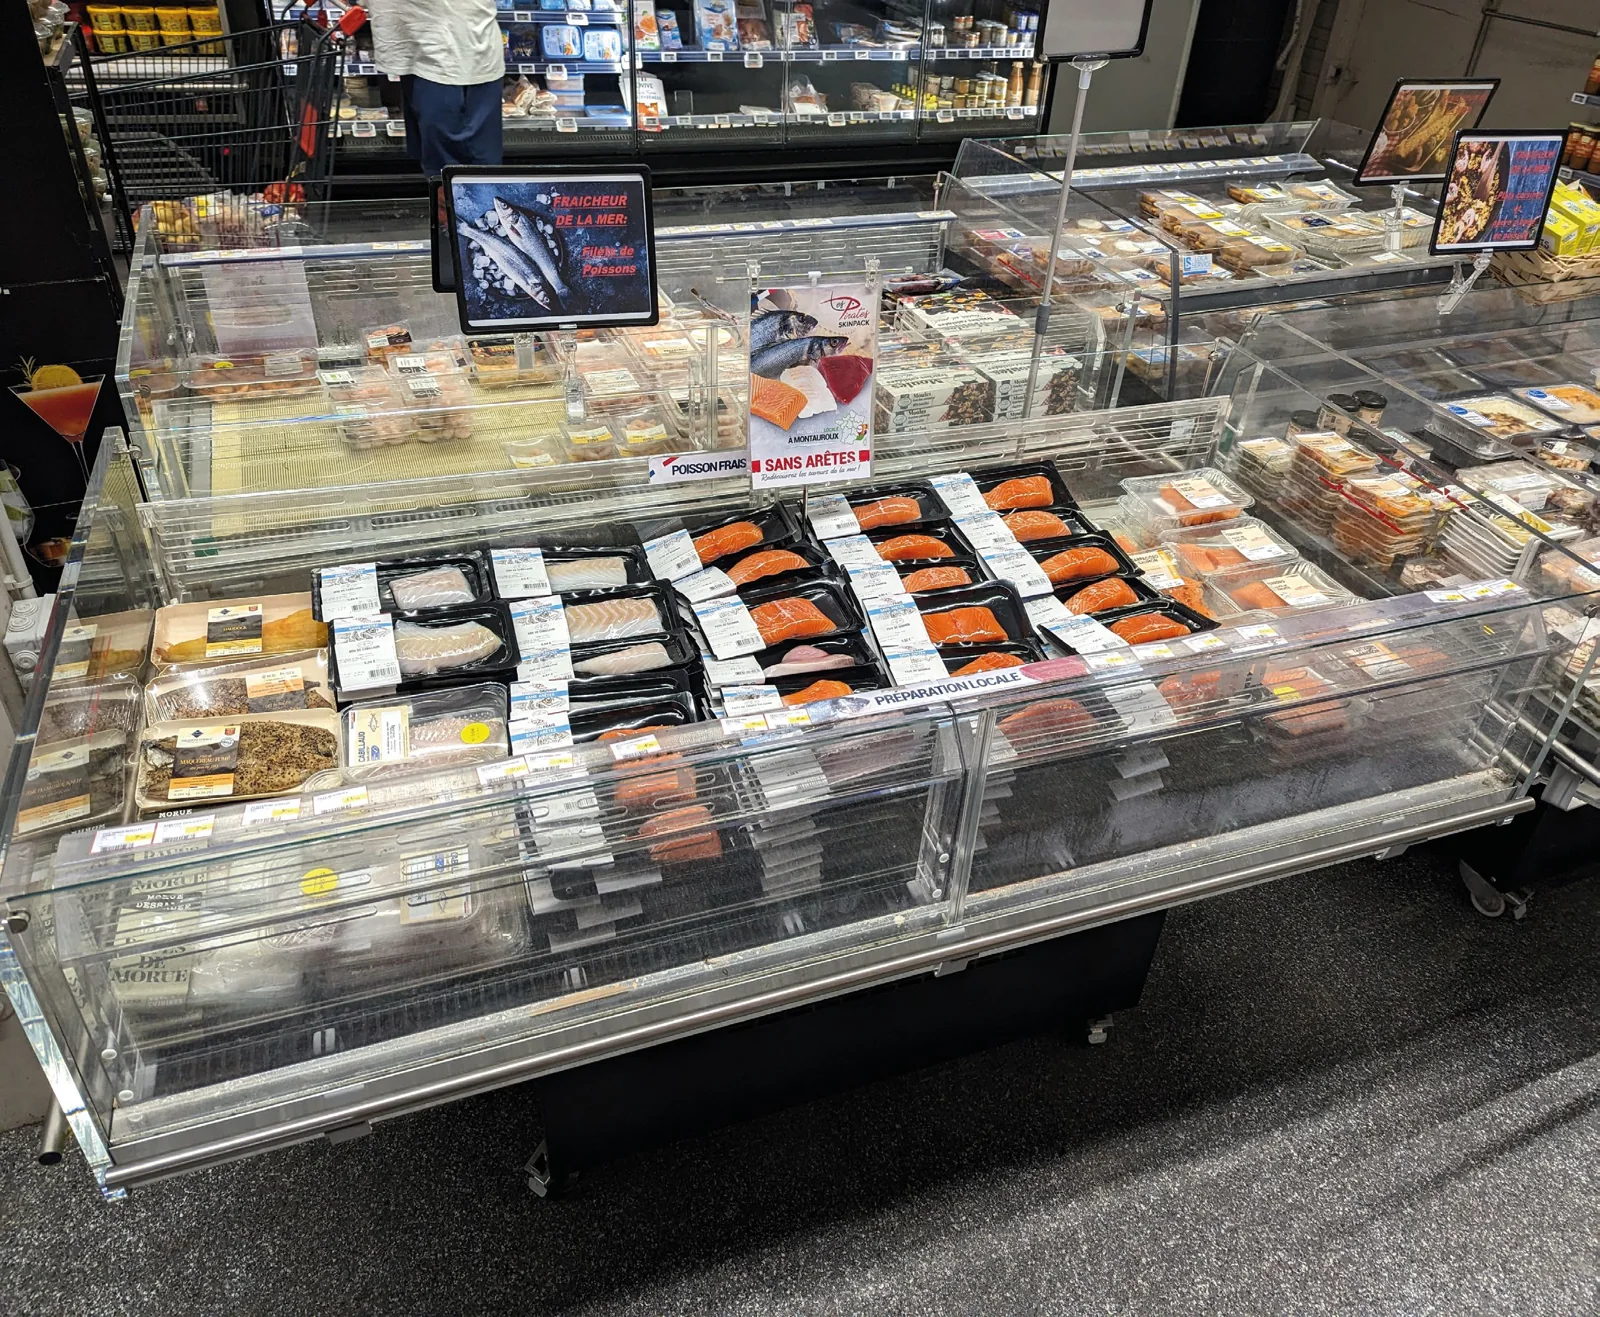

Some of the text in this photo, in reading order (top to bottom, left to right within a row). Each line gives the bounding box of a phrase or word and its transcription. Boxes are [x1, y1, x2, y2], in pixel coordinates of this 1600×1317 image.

[552, 195, 628, 208] FRAICHEUR
[556, 213, 628, 226] DE LA MER:
[620, 246, 634, 256] de
[582, 264, 636, 276] Poissons
[838, 320, 870, 328] SKINPACK
[794, 433, 839, 443] MONTAUROUX
[672, 458, 747, 476] POISSON FRAIS
[766, 450, 856, 472] SANS ARÊTES
[874, 672, 1021, 706] PRÉPARATION LOCALE
[358, 731, 366, 762] CABILLAUD
[110, 968, 188, 984] MORUE
